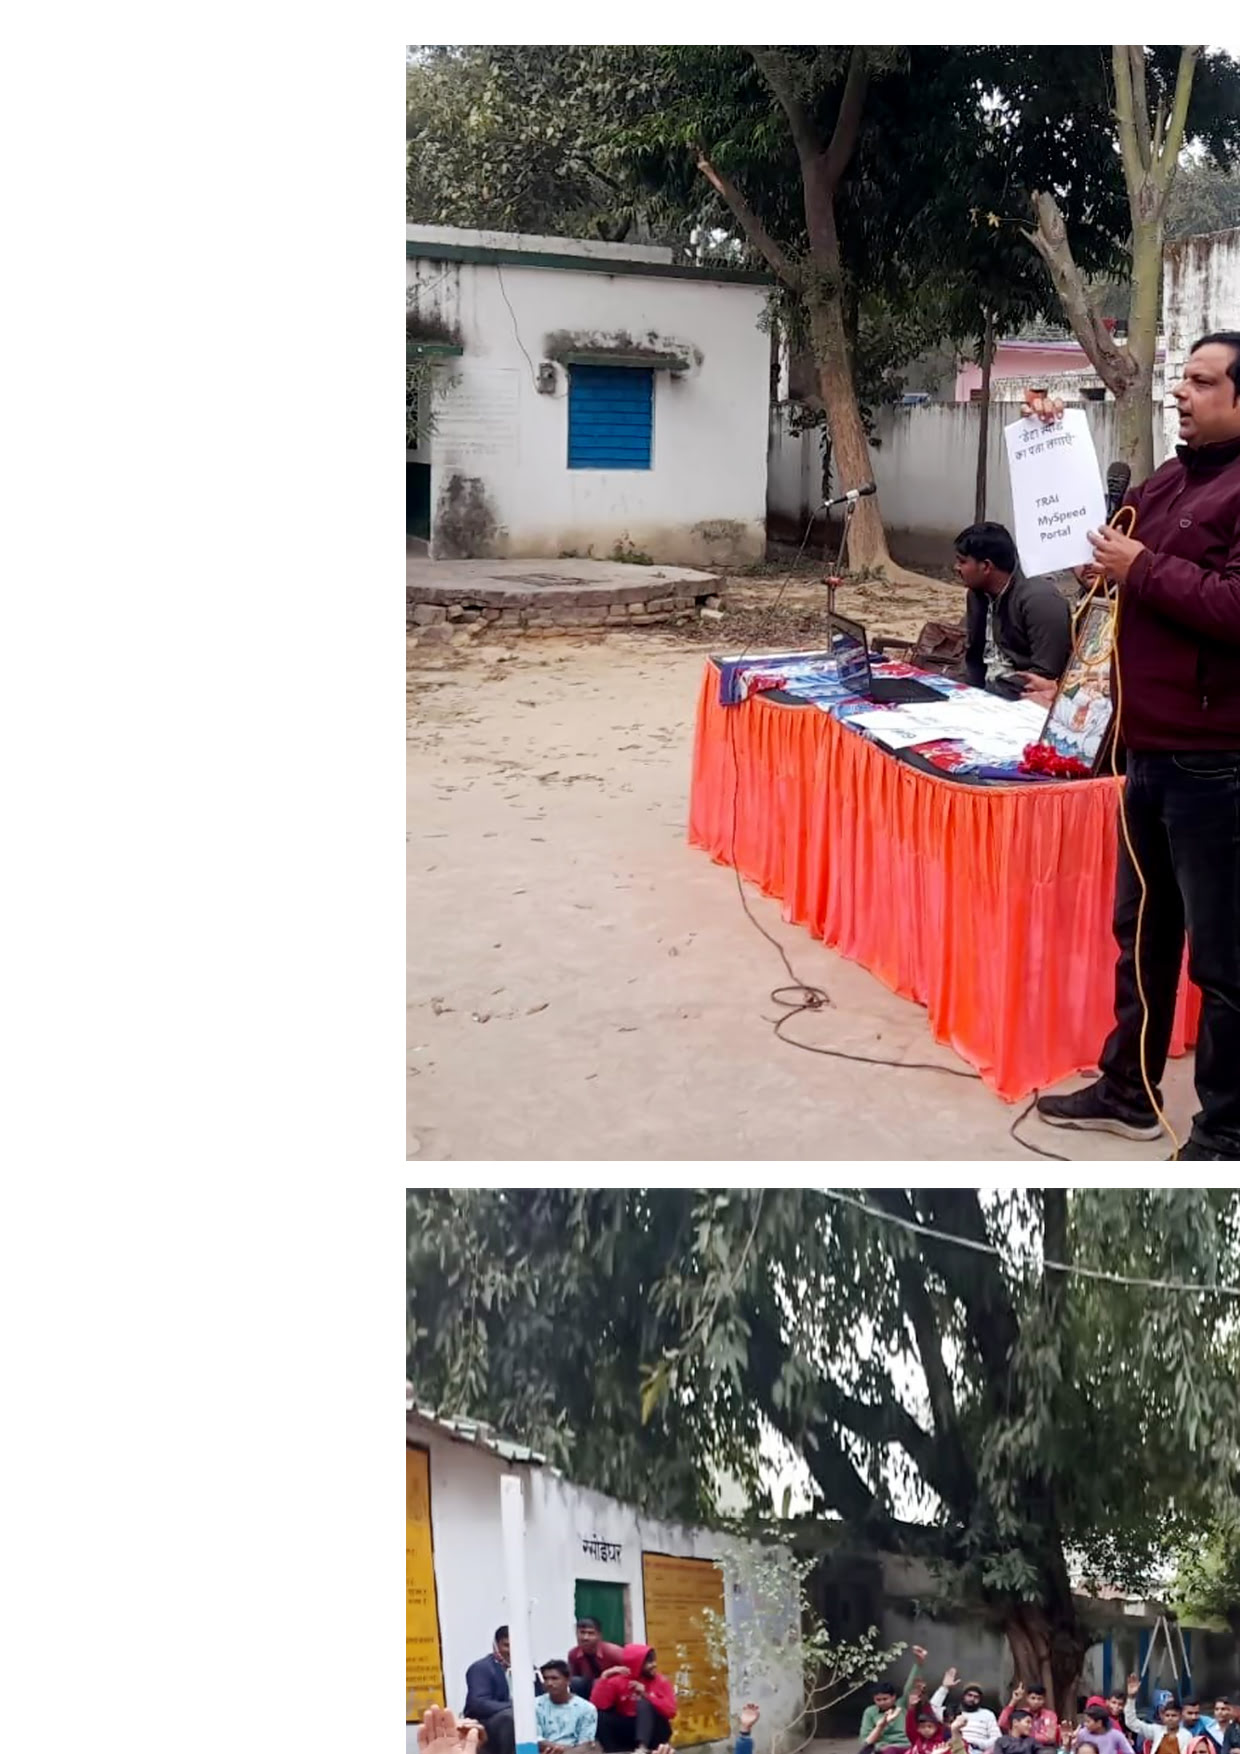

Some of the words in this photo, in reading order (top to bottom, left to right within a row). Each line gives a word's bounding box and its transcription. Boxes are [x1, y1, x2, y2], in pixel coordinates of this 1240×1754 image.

[1035, 493, 1059, 508] TRAI
[1037, 505, 1086, 526] MySpeed
[1040, 524, 1071, 542] Portal
